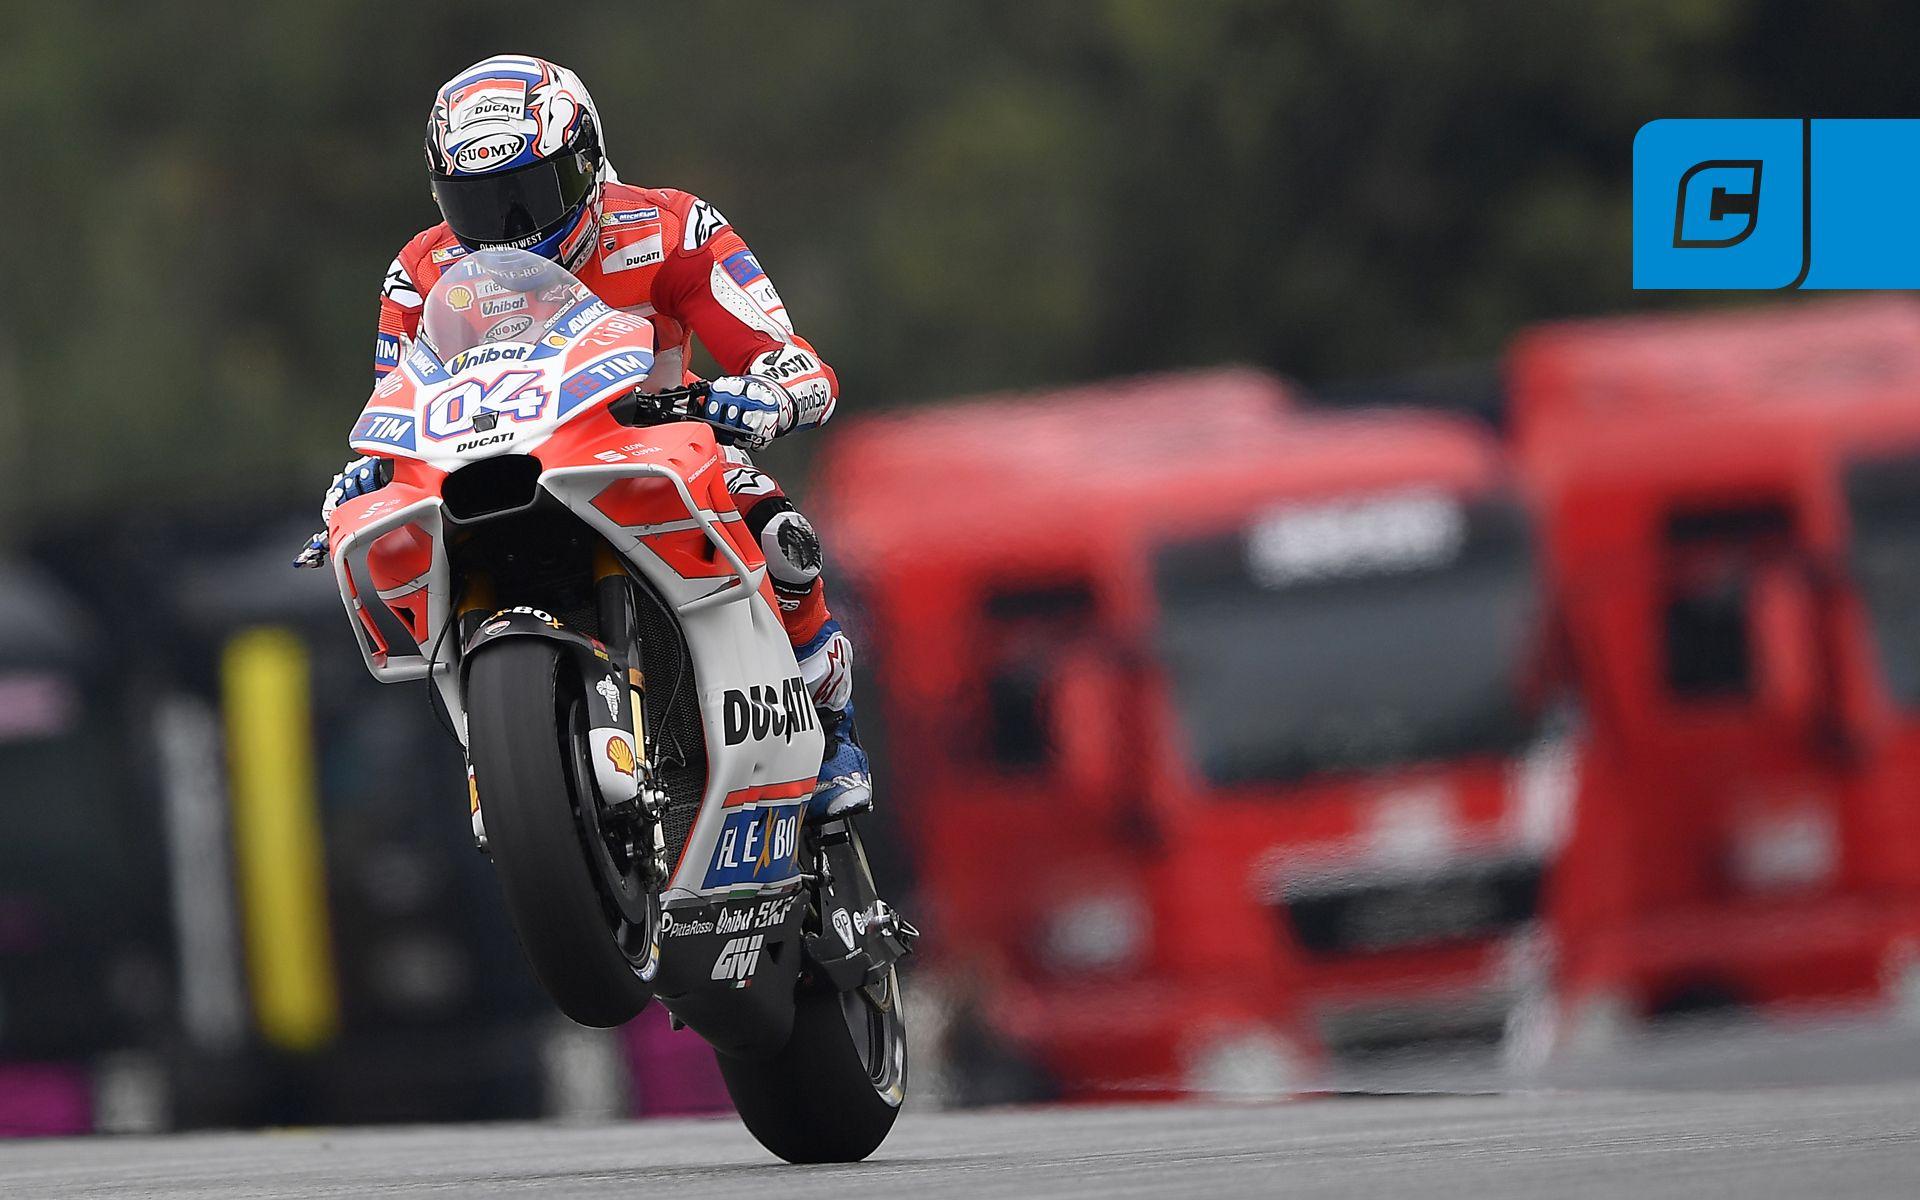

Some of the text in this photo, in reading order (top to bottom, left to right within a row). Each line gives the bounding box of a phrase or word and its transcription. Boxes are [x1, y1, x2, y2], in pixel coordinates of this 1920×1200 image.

[475, 104, 520, 115] DUCATI
[460, 142, 518, 162] SUOMY
[619, 211, 656, 220] MICHELIN
[496, 241, 518, 252] WILD
[519, 234, 542, 248] WEST
[626, 251, 660, 266] DUCATI
[482, 297, 524, 315] Unibat
[489, 321, 529, 337] SUOMY
[451, 346, 527, 376] Unibat
[588, 354, 648, 381] TIM
[424, 370, 552, 442] 04
[365, 417, 413, 442] TIM
[456, 432, 515, 453] DUCATI
[723, 676, 814, 746] DUCATI
[670, 920, 714, 938] PittaRosso
[754, 896, 797, 928] SKF
[711, 934, 764, 980] GIVI
